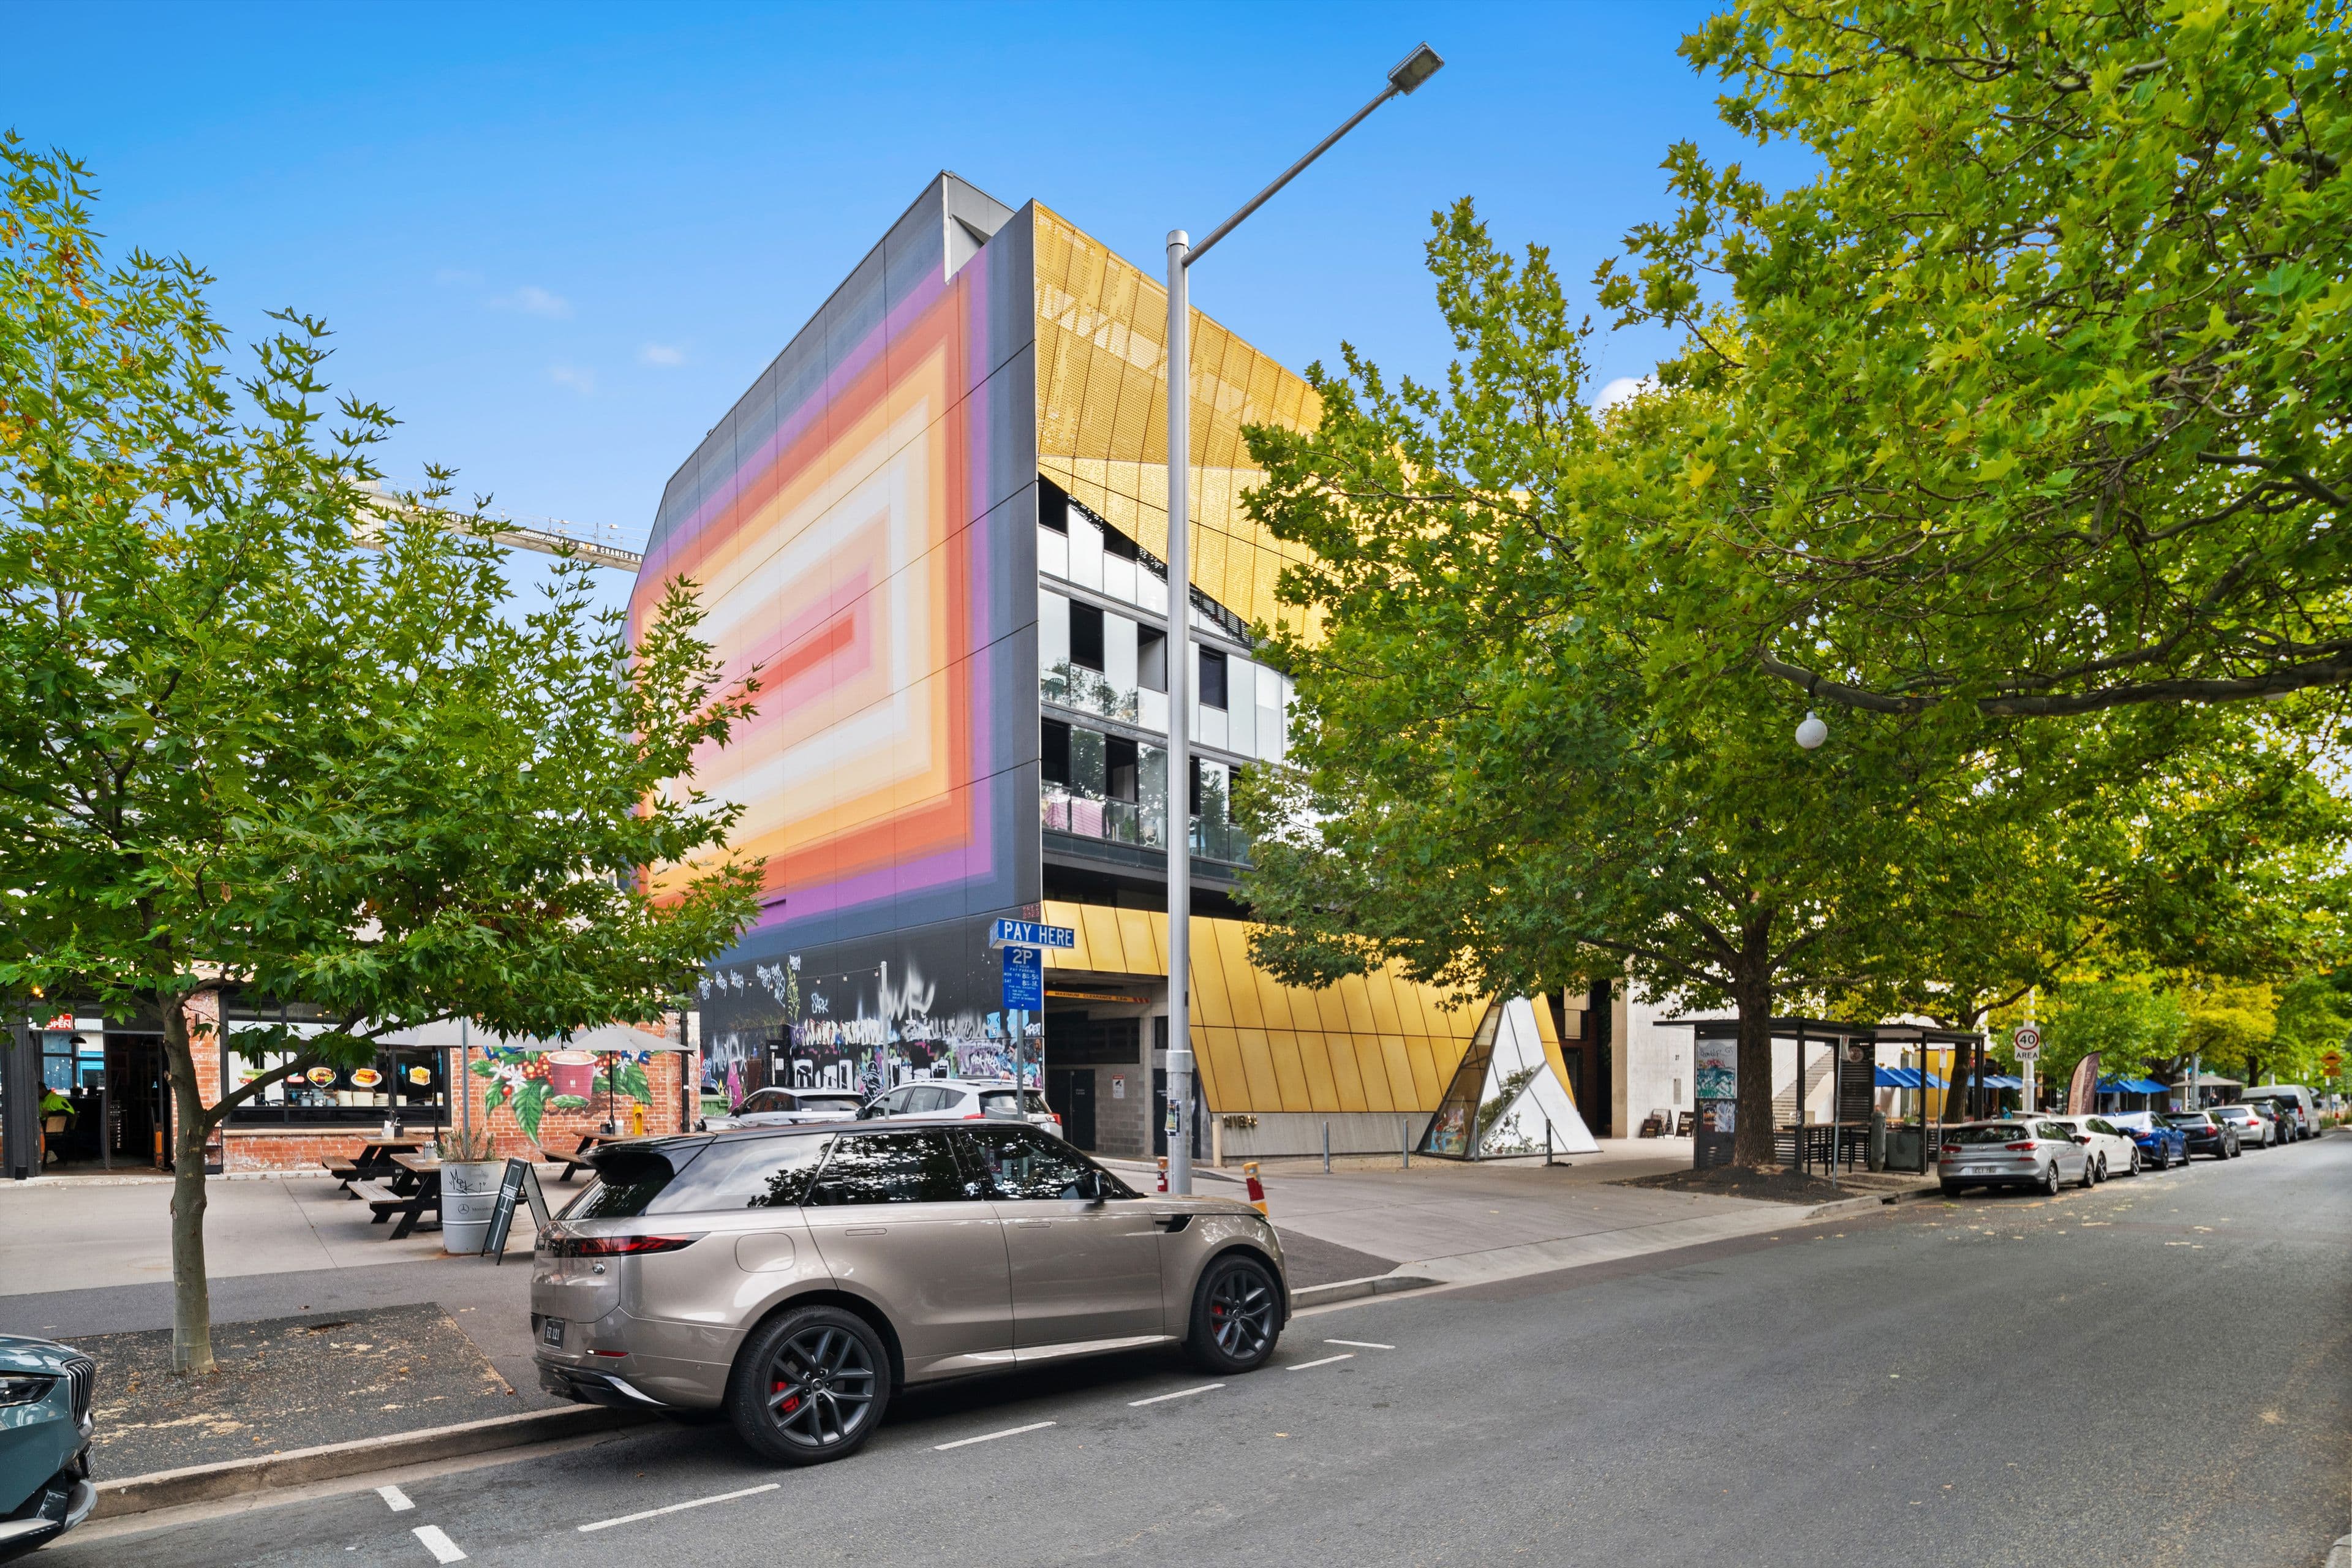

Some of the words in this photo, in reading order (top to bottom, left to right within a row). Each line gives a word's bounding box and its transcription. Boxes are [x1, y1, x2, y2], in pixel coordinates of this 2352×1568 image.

[601, 546, 628, 559] CRANES
[1005, 921, 1032, 941] PAY
[1039, 925, 1073, 946] HERE
[1012, 949, 1033, 964] 2P
[46, 1019, 72, 1028] OPEN
[2019, 1035, 2035, 1044] 40
